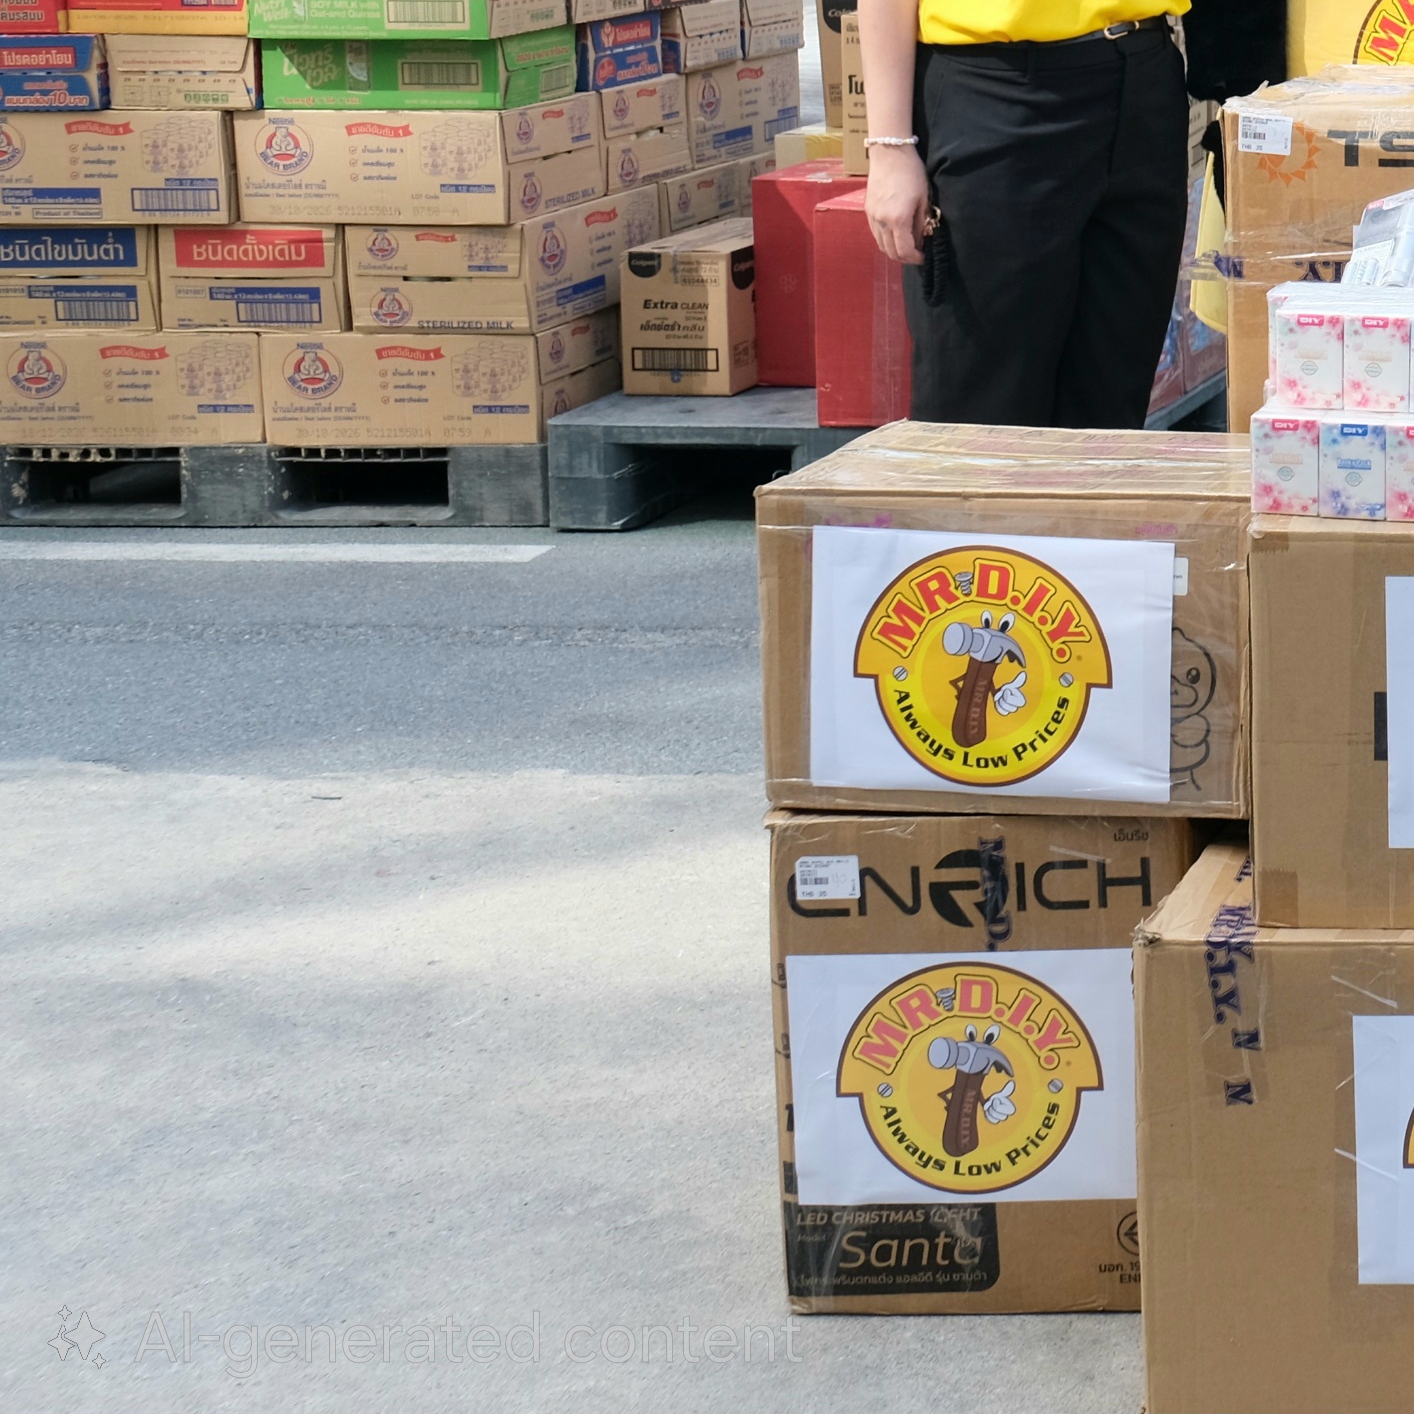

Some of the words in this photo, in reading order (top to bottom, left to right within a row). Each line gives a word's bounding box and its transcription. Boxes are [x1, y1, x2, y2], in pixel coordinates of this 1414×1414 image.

[3, 48, 72, 67] โปรดอย่าโยน
[0, 231, 125, 261] ชนิดไขมันต่ำ
[192, 233, 306, 262] ชนิดดั้งเดิม
[643, 299, 678, 310] Extra
[680, 302, 709, 310] CLEAN
[417, 320, 483, 330] STERILIZED
[486, 320, 514, 330] MILK
[1299, 316, 1321, 325] DIY
[1363, 319, 1387, 328] DIY
[893, 688, 955, 762] Always
[961, 750, 1008, 769] Low
[1011, 695, 1071, 762] Prices
[879, 1104, 946, 1173] Always
[953, 1159, 1002, 1177] Low
[1007, 1100, 1061, 1166] Prices
[796, 1210, 828, 1226] LED
[831, 1208, 926, 1226] CHRISTMAS
[839, 1230, 983, 1269] Santa
